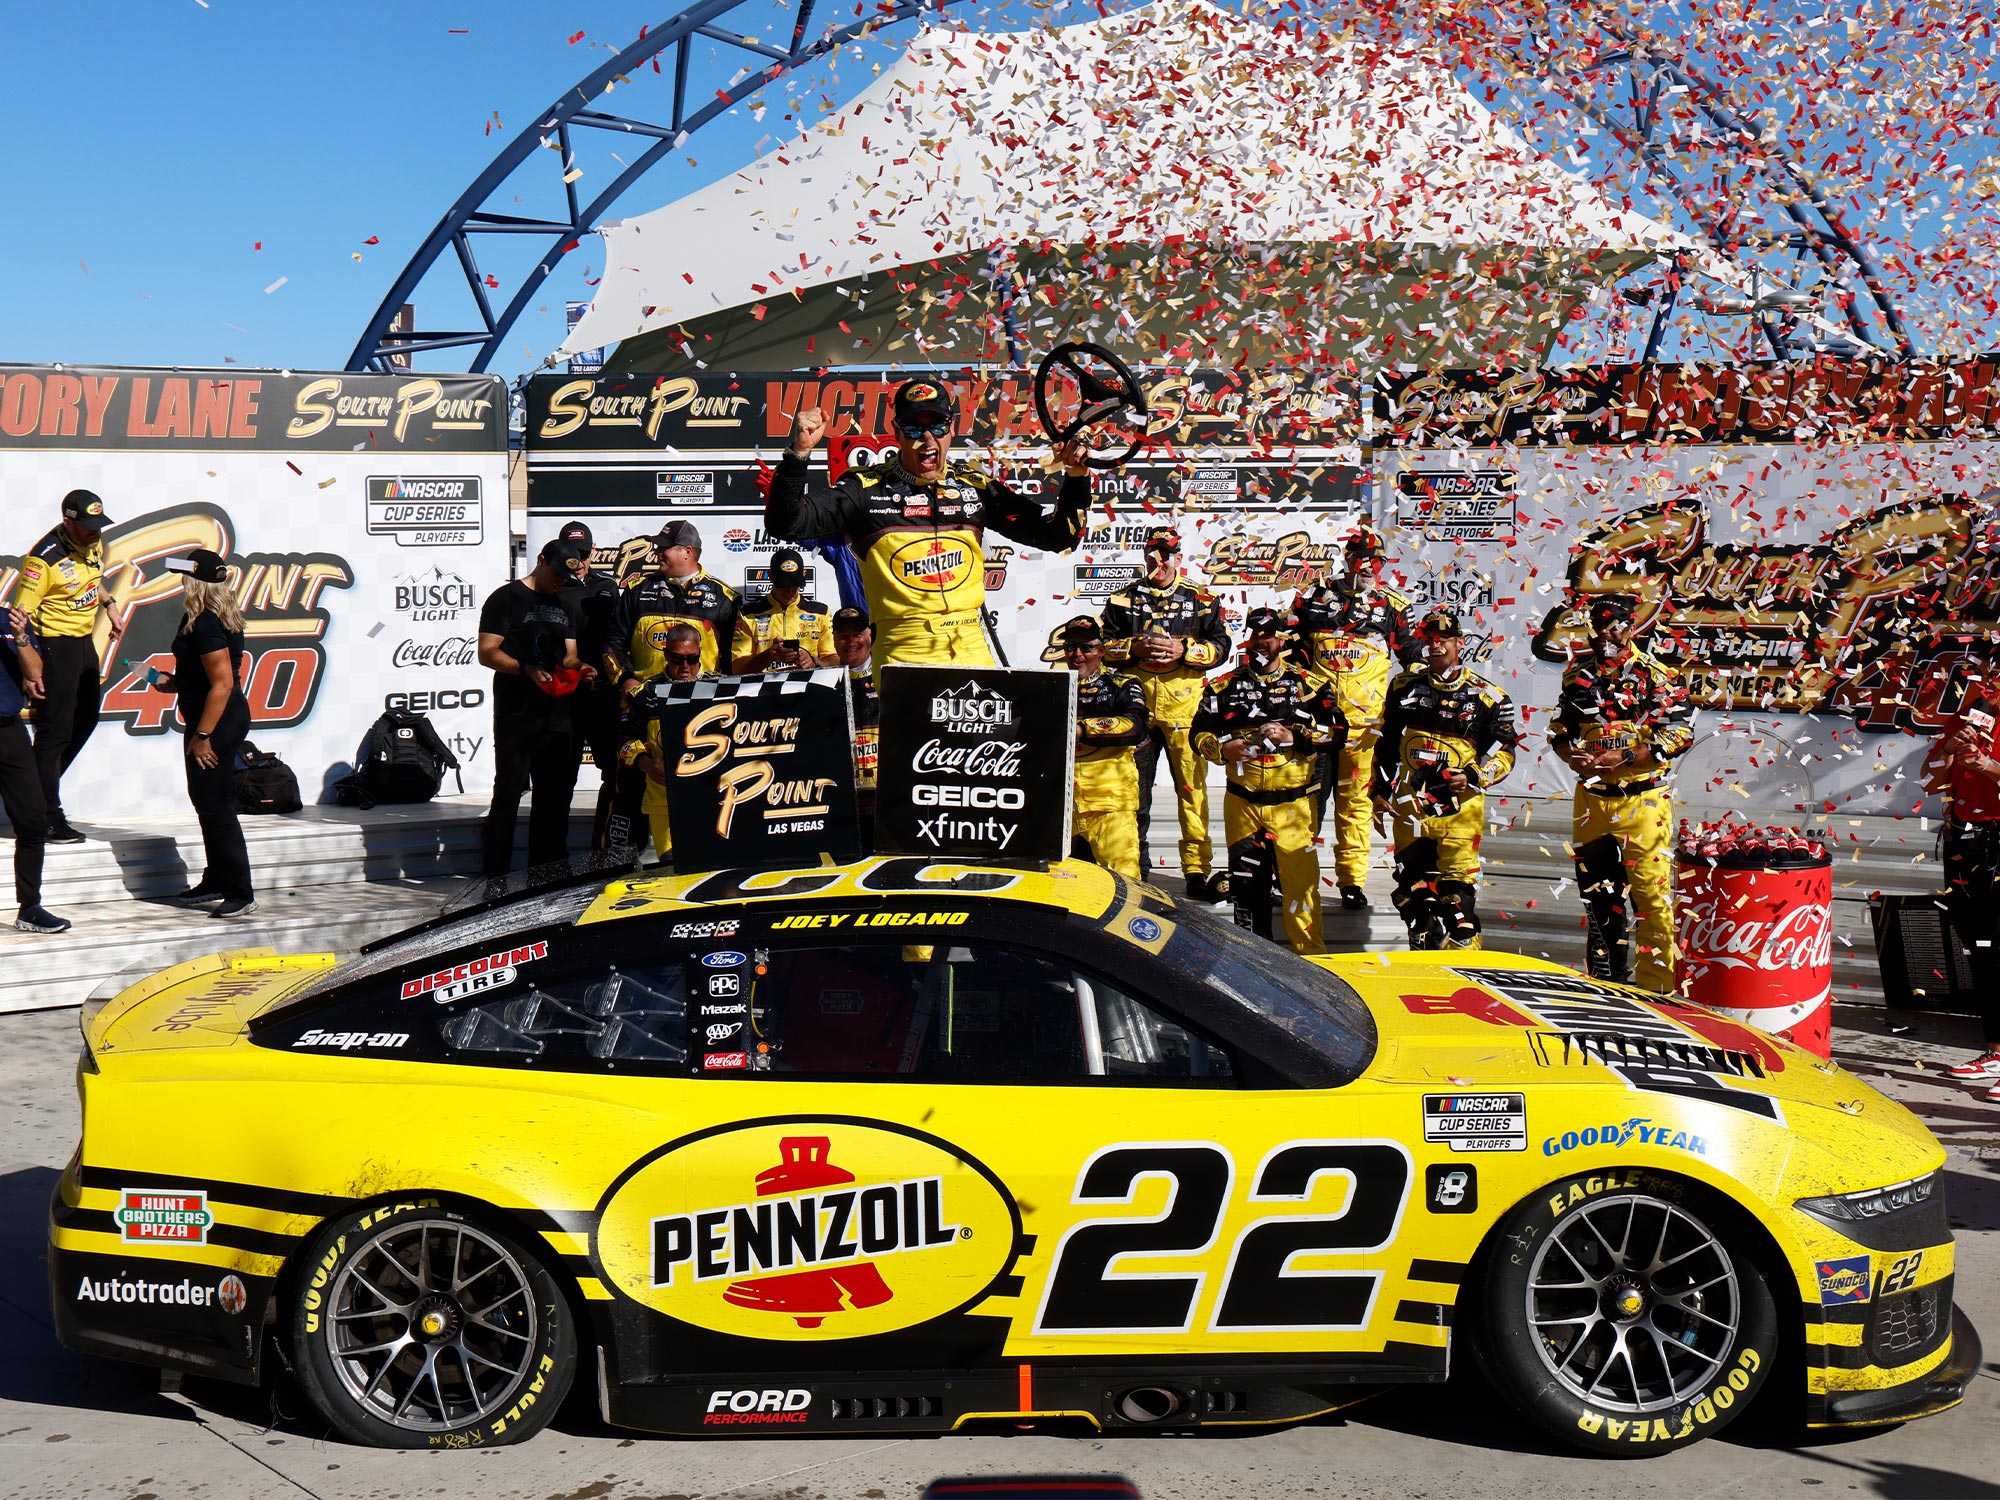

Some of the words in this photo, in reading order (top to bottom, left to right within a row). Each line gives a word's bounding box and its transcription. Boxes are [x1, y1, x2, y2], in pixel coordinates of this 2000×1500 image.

[0, 373, 119, 437] ORY
[126, 379, 262, 438] LANE
[674, 474, 706, 482] NASCAR
[1199, 471, 1230, 479] NASCAR
[404, 482, 465, 498] NASCAR
[664, 485, 678, 493] CUP
[680, 485, 706, 493] SERIES
[383, 507, 414, 521] CUP
[415, 506, 466, 521] SERIES
[414, 532, 466, 543] PLAYOFFS
[903, 550, 964, 578] PENNZOIL
[1097, 568, 1134, 578] NASCAR
[1084, 582, 1102, 591] CUP
[394, 585, 476, 612] BUSCH
[411, 610, 459, 622] LIGHT
[533, 605, 565, 615] TEAM
[939, 619, 960, 627] JOEY
[392, 637, 479, 669] Coca-Cola
[101, 648, 320, 729] 40
[384, 689, 485, 712] GEICO
[930, 697, 1013, 725] BUSCH
[946, 721, 994, 734] LIGHT
[912, 738, 1028, 777] Coca-Cola
[911, 784, 1026, 810] GEICO
[768, 822, 788, 835] LAS
[790, 820, 824, 833] VEGAS
[915, 812, 1018, 850] xfinity
[771, 913, 848, 929] JOEY
[853, 911, 970, 928] LOGANO
[710, 953, 738, 965] Ford
[401, 940, 549, 1000] DISCOUNT
[442, 972, 508, 999] TIRE
[711, 976, 738, 995] PPG
[700, 1003, 748, 1016] Mazak
[709, 1024, 730, 1038] AAA
[292, 1029, 410, 1051] Snap-on
[704, 1053, 745, 1068] Coca-Cola
[1456, 1098, 1509, 1112] NASCAR
[1438, 1118, 1465, 1131] CUP
[1466, 1117, 1512, 1131] SERIES
[1465, 1138, 1511, 1149] PLAYOFFS
[1439, 1171, 1469, 1206] 8
[1548, 1169, 1643, 1218] EAGLE
[141, 1197, 187, 1211] HUNT
[123, 1210, 206, 1225] BROTHERS
[140, 1224, 189, 1237] PIZZA
[652, 1176, 961, 1288] PENNZOIL
[1032, 1139, 1414, 1334] 22
[1821, 1271, 1869, 1291] SUNOCO
[1880, 1251, 1924, 1296] 22
[77, 1276, 215, 1307] Autotrader
[706, 1389, 812, 1413] FORD
[703, 1411, 809, 1426] PERFORMANCE
